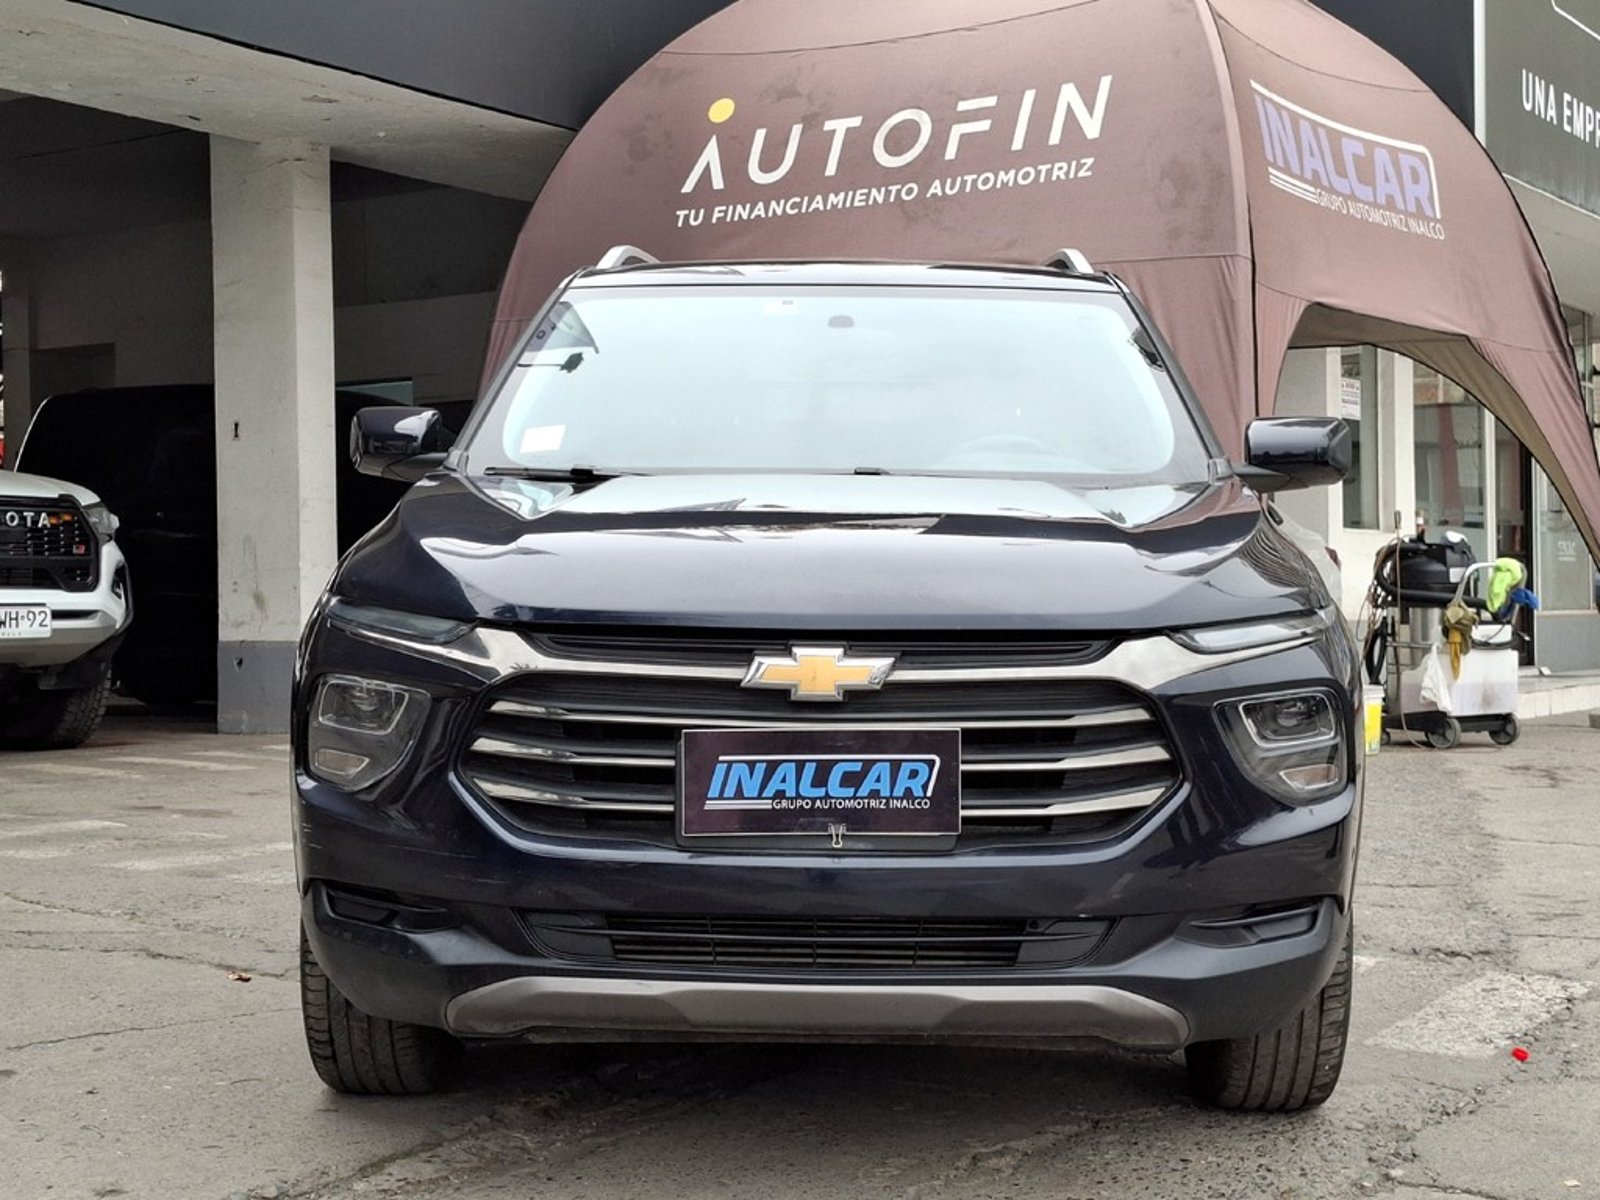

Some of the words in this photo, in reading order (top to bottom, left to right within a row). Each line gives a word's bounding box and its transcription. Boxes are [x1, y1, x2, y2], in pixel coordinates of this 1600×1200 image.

[1522, 68, 1557, 126] UNA
[681, 75, 1113, 193] AUTOFIN
[1254, 93, 1435, 218] INALCAR
[676, 210, 704, 227] TU
[711, 182, 918, 224] FINANCIAMIENTO
[926, 157, 1095, 198] AUTOMOTRIZ
[1316, 188, 1348, 215] GRUPO
[1347, 200, 1408, 232] AUTOMOTRIZ
[1407, 217, 1445, 240] INALCO
[707, 761, 930, 798] INALCAR
[772, 799, 812, 809] GRUPO
[814, 799, 887, 809] AUTOMOTRIZ
[889, 799, 931, 809] INALCO
